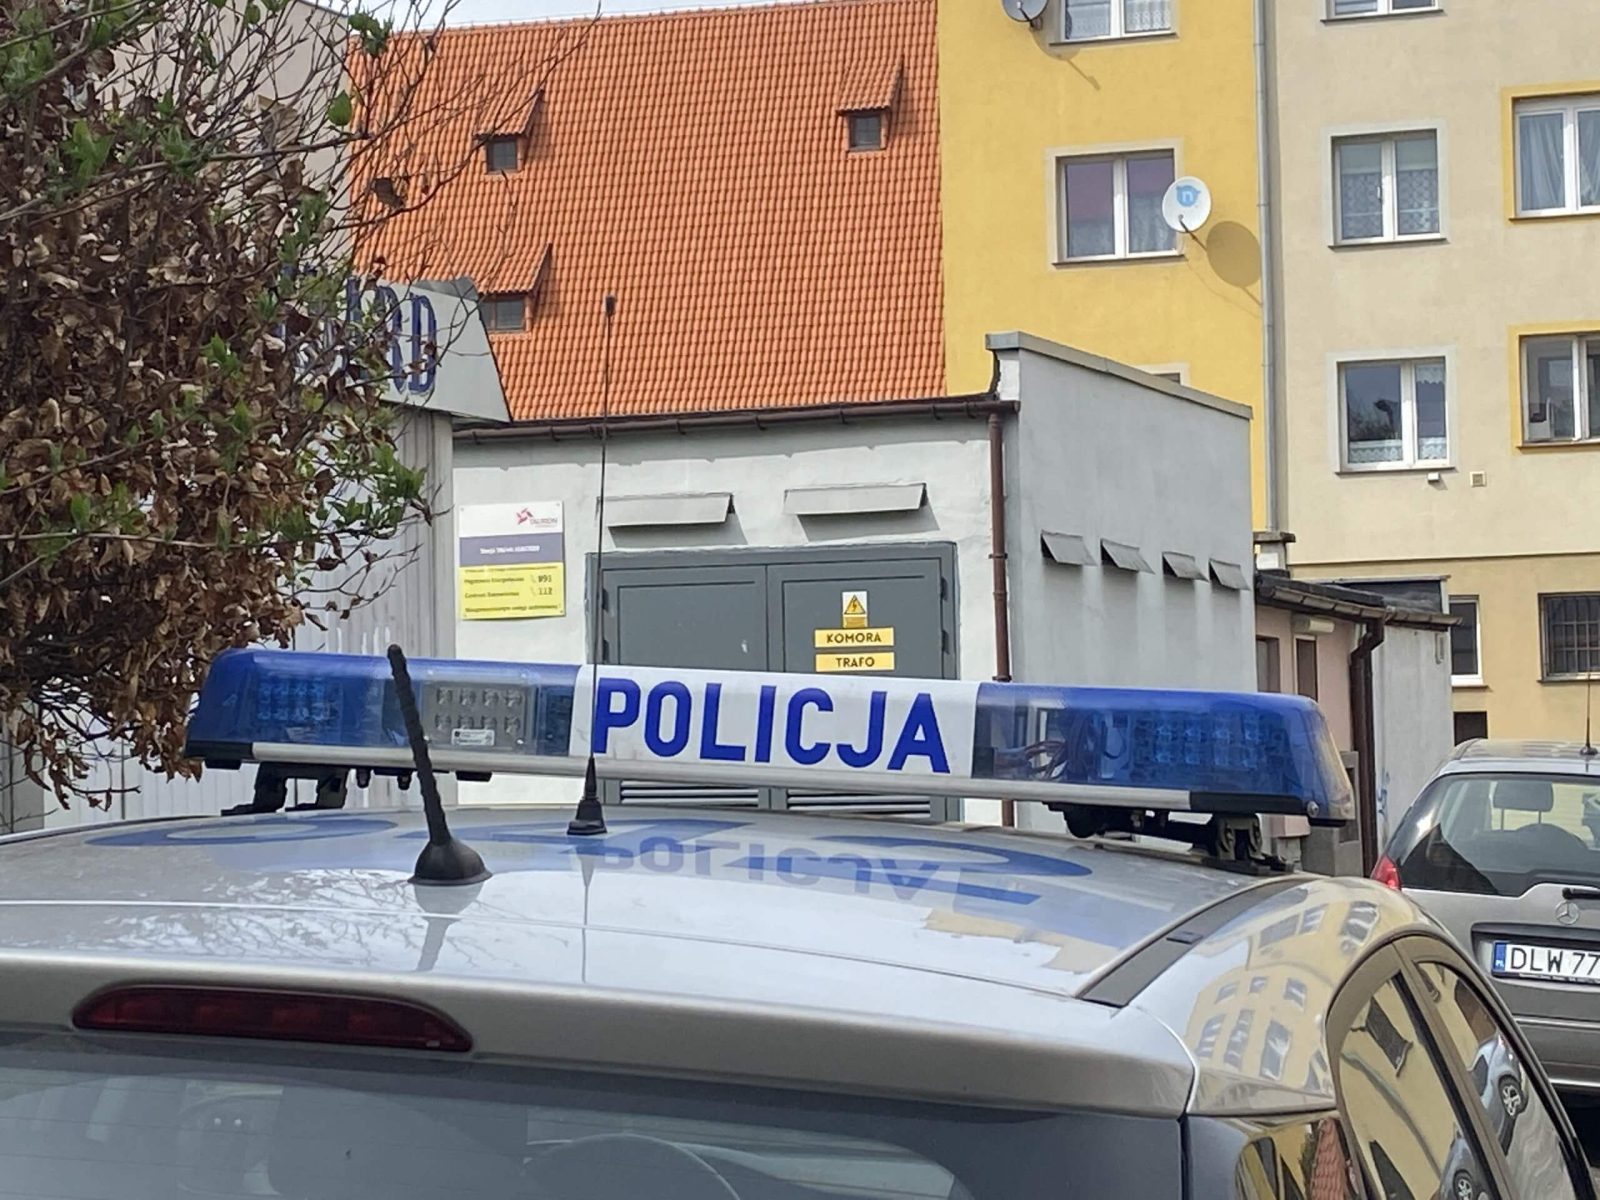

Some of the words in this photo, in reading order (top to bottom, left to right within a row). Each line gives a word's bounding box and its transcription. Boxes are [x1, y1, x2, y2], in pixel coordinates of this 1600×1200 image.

[826, 632, 882, 644] KOMORA
[835, 656, 875, 668] TRAFO
[593, 677, 951, 774] POLICJA
[1510, 946, 1563, 974] DLW
